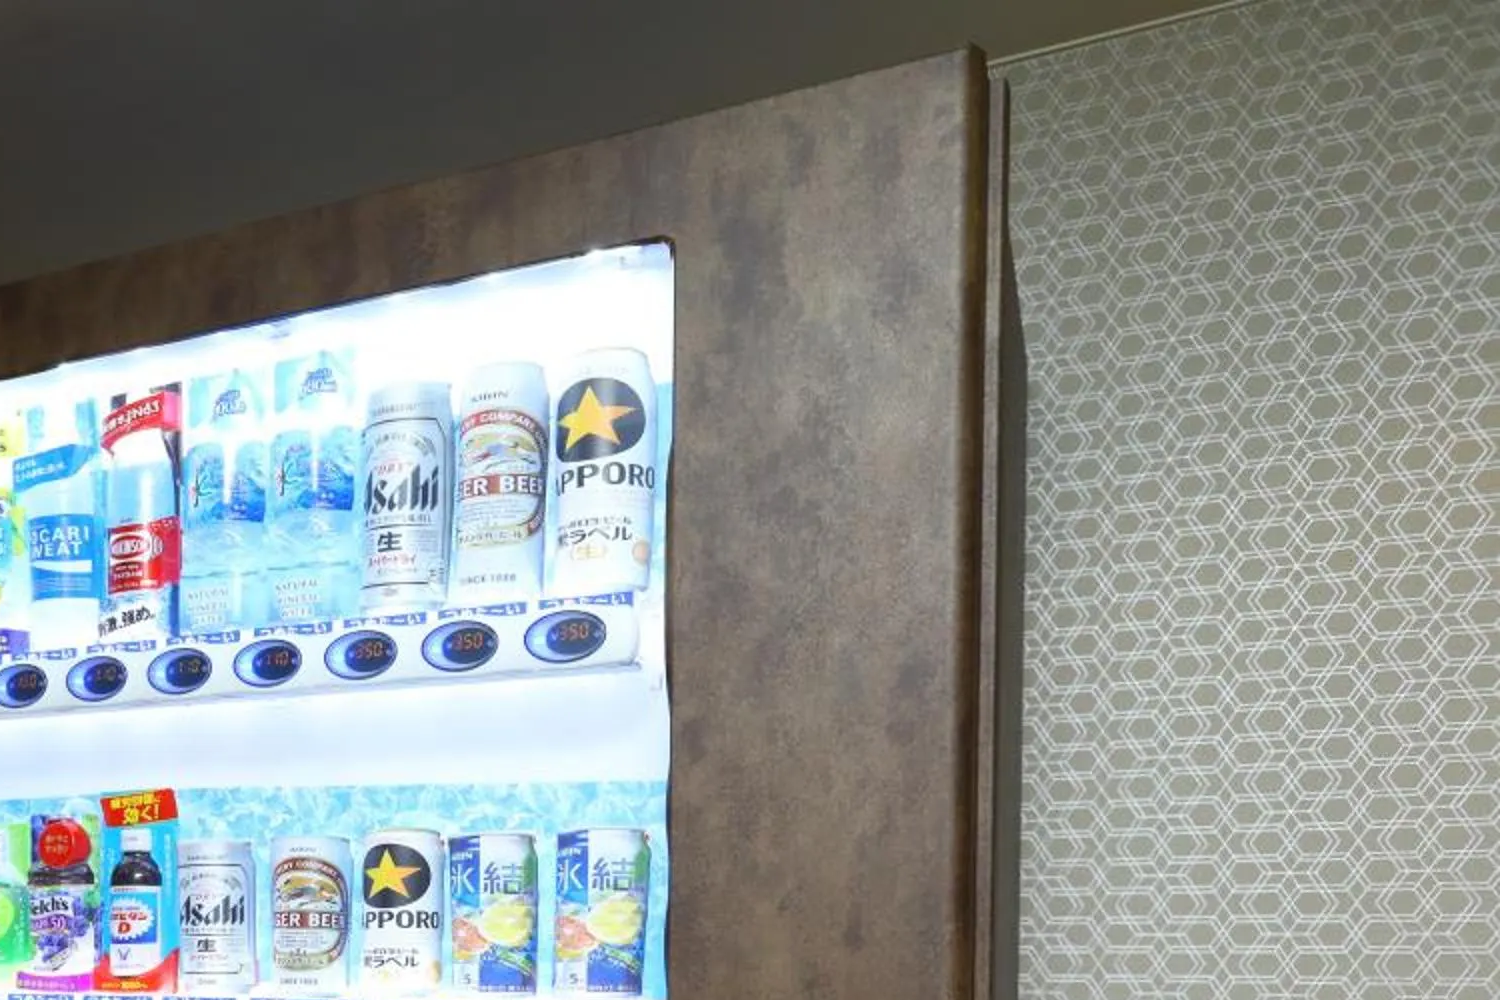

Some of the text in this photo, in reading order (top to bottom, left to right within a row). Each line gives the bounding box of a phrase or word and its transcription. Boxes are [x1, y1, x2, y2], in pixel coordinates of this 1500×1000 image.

[377, 532, 402, 552] 生
[451, 861, 524, 895] 氷結
[558, 857, 632, 892] 氷結
[180, 895, 245, 926] Asahi
